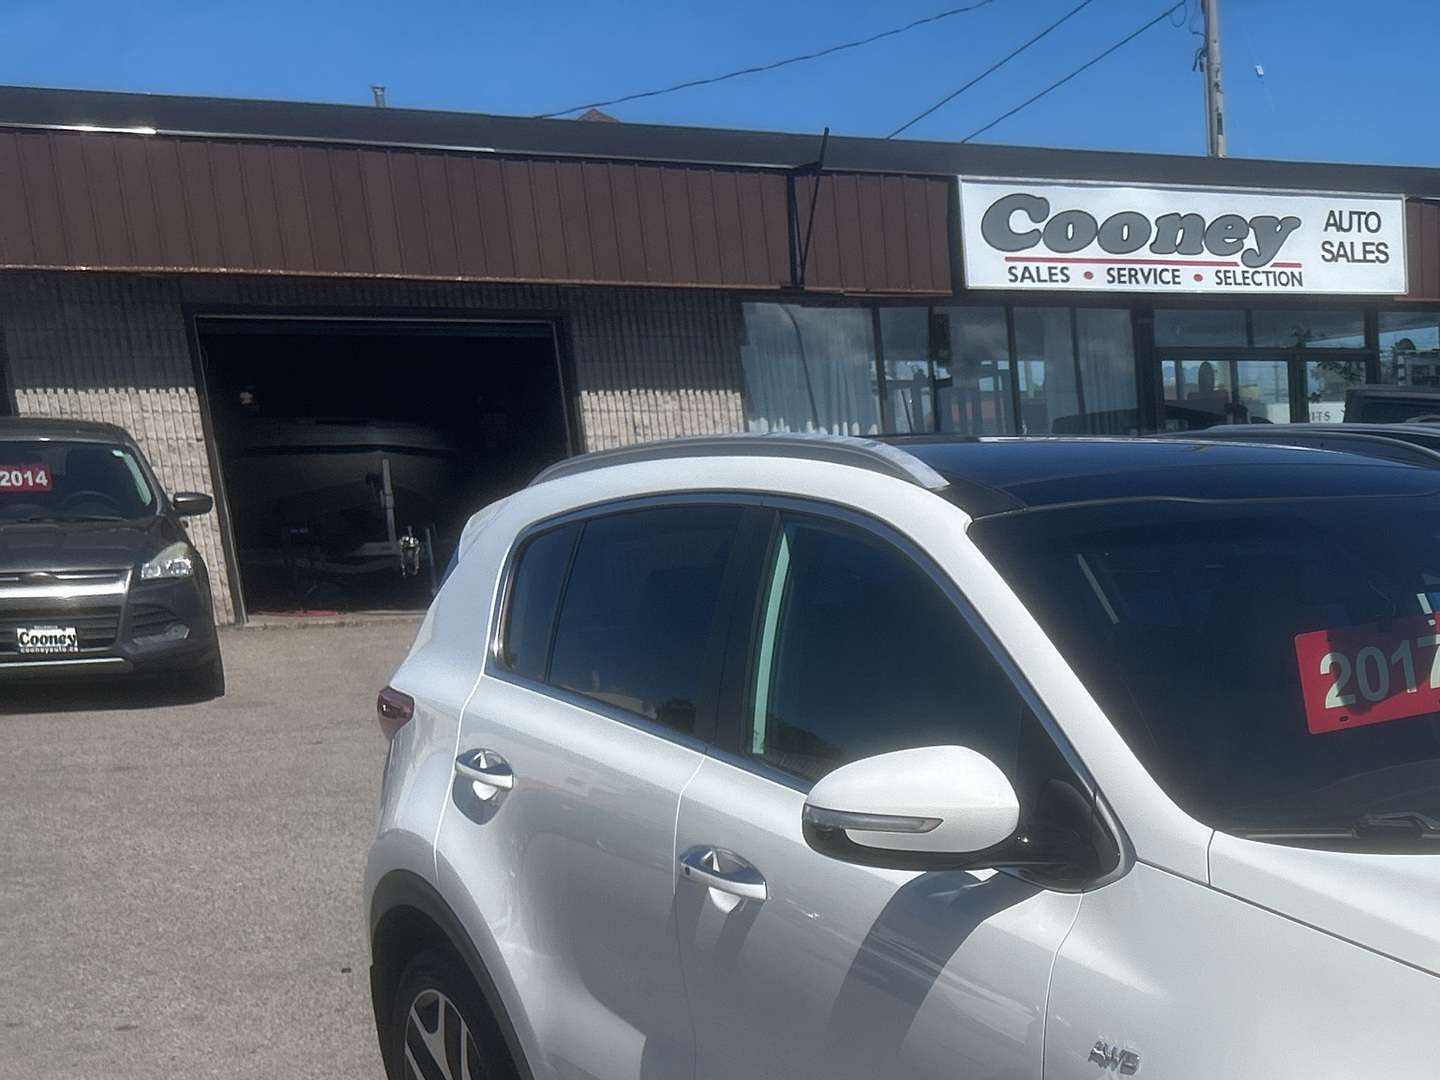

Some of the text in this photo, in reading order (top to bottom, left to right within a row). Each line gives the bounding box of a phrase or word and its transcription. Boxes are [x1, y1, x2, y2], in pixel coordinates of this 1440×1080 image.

[981, 193, 1302, 268] Cooney
[1323, 210, 1382, 233] AUTO
[1321, 241, 1390, 264] SALES
[1007, 266, 1303, 287] SALES SERVICE SELECTION
[0, 470, 49, 487] 2014
[19, 631, 77, 647] Cooney
